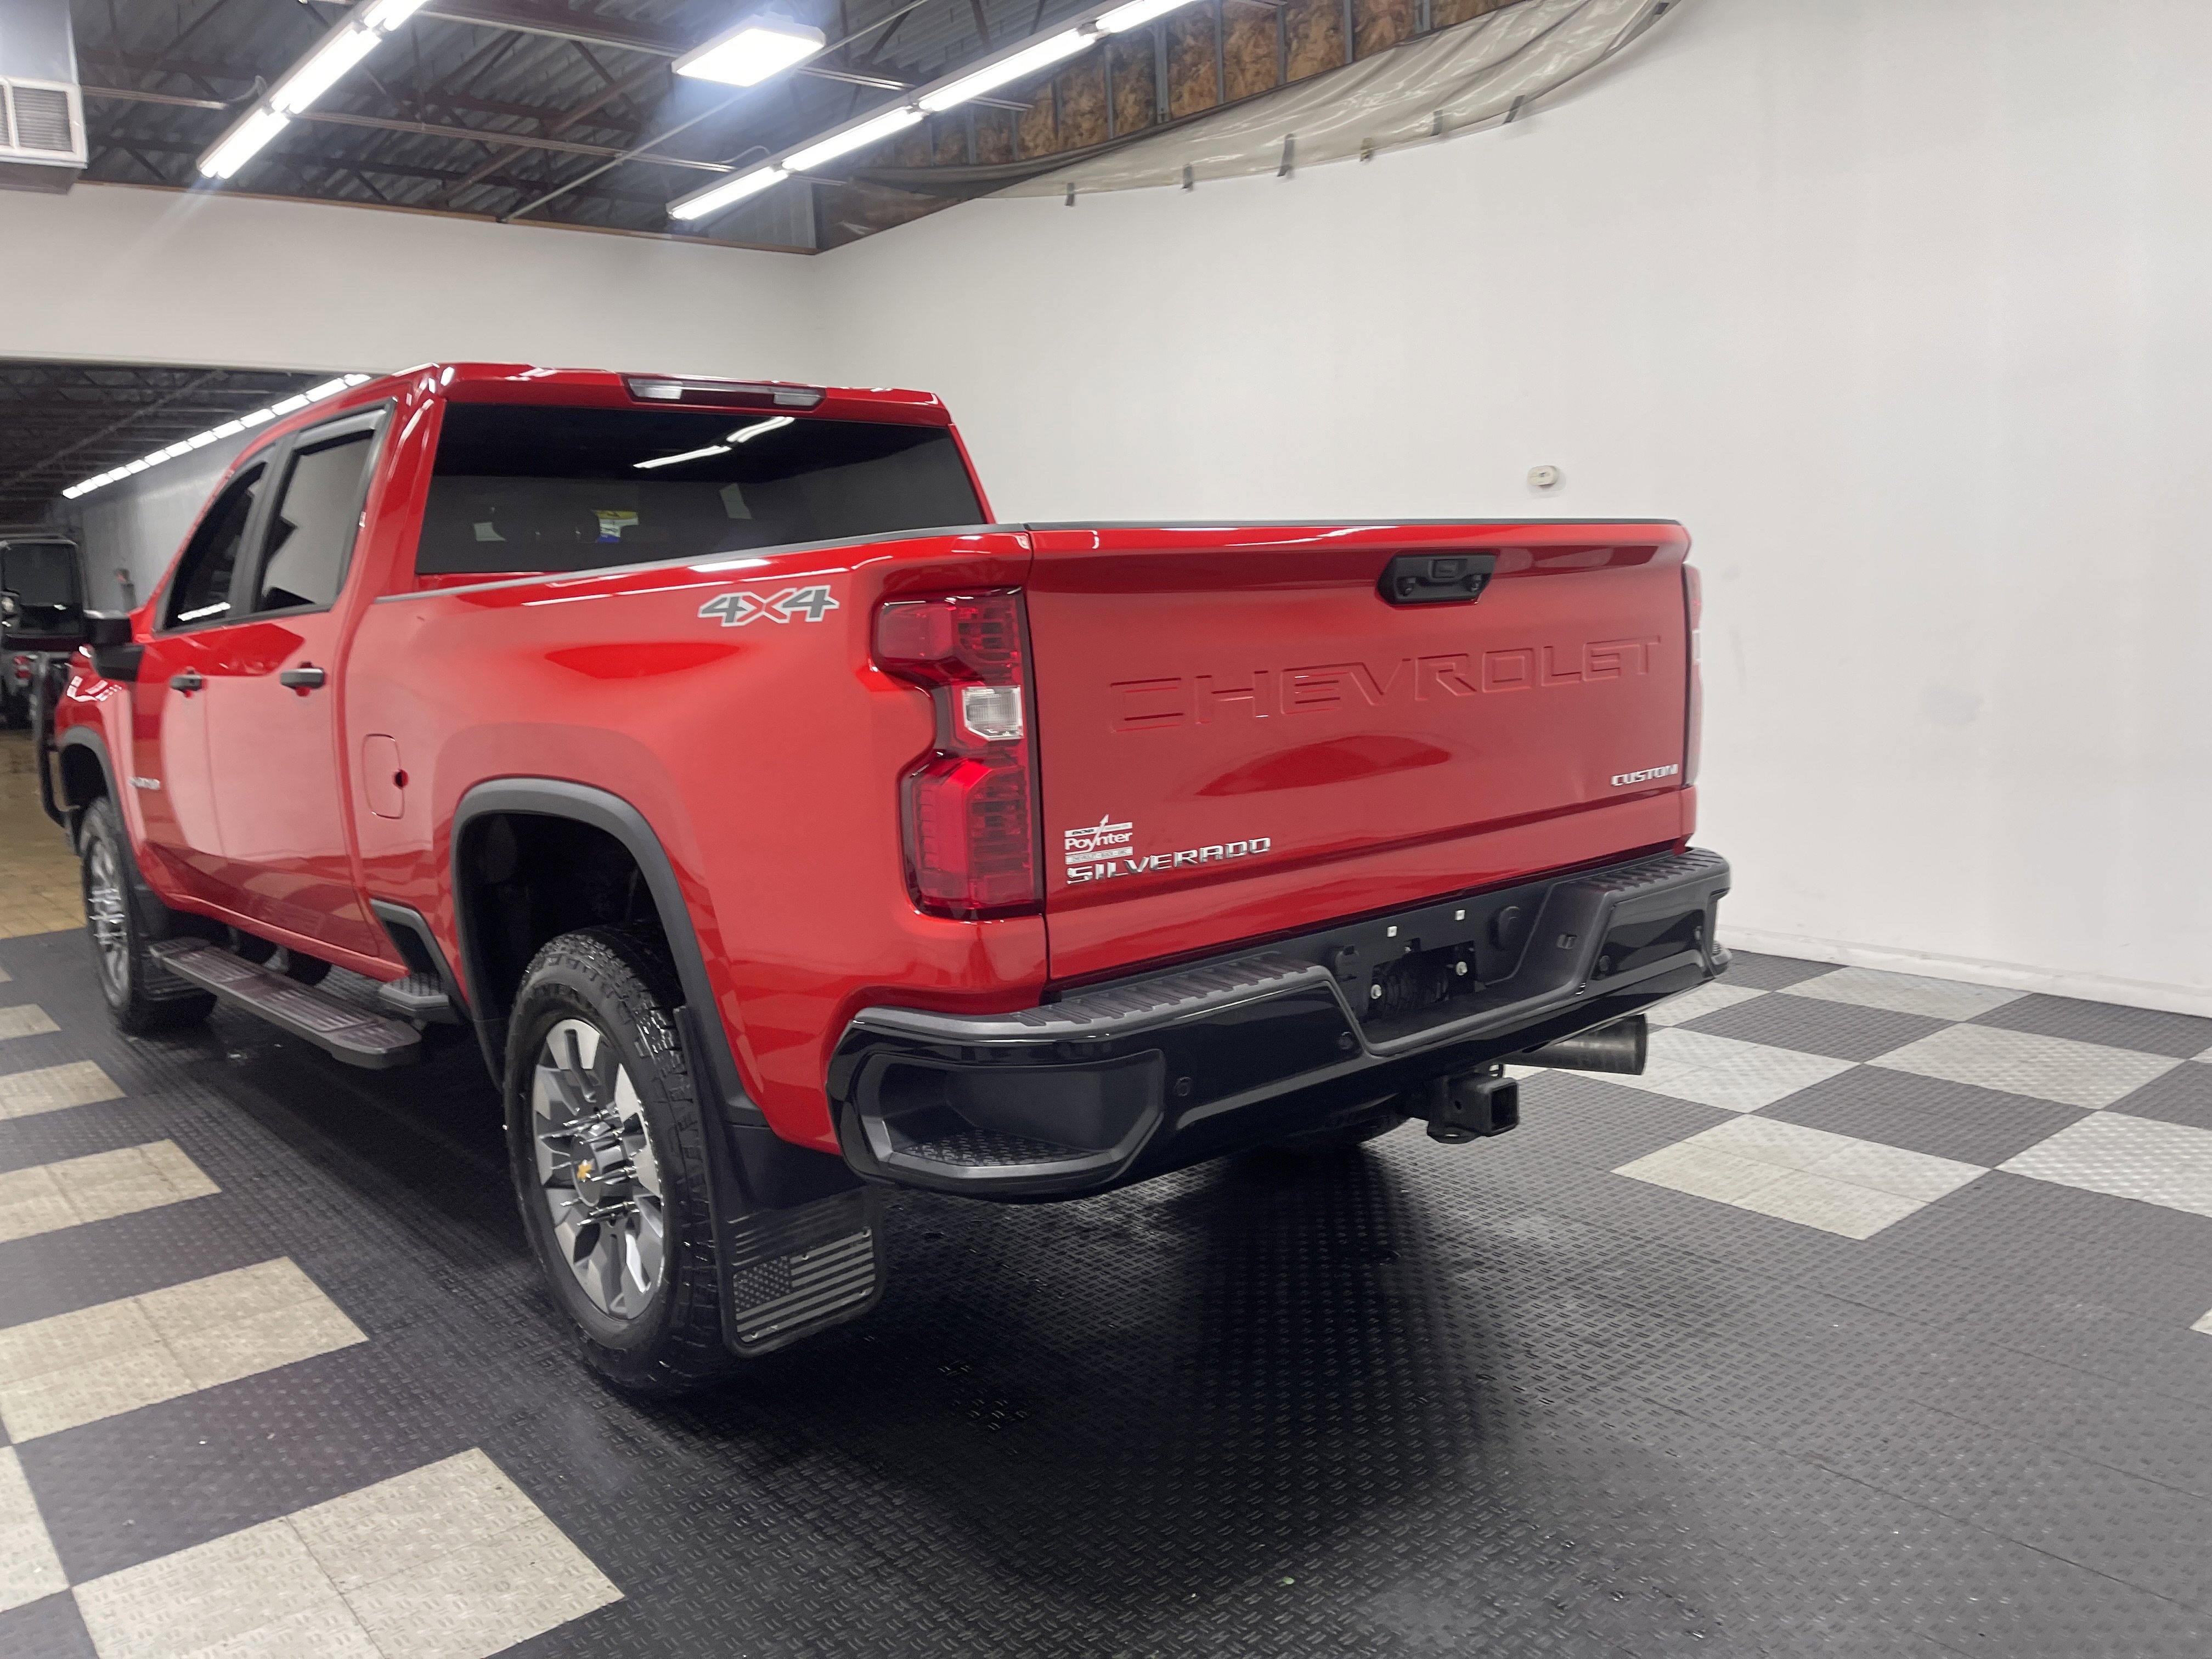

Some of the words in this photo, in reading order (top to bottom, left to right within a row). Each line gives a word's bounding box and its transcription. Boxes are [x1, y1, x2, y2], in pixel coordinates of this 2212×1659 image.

[1110, 635, 1661, 733] CHEVROLET
[1611, 764, 1679, 786] CUSTOM
[1064, 832, 1133, 853] Poynter
[1066, 837, 1271, 884] SILVERADO
